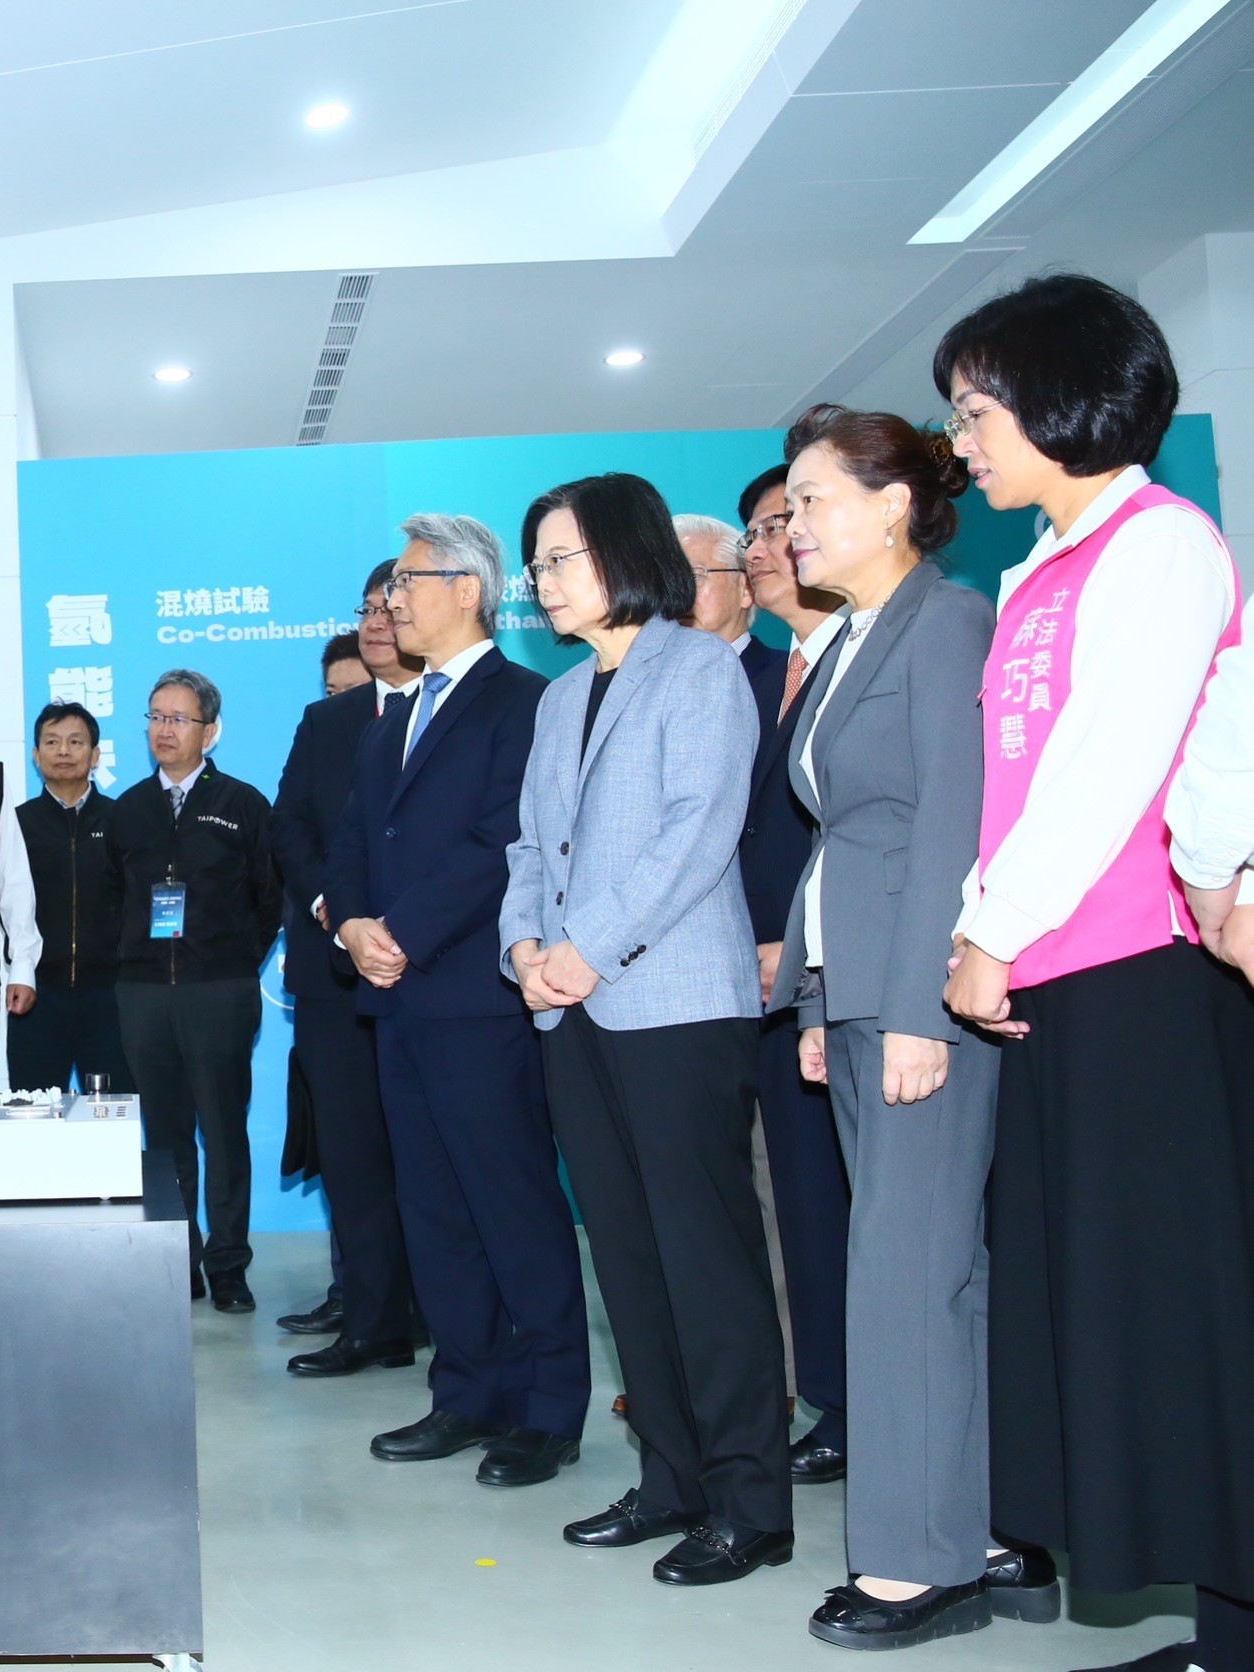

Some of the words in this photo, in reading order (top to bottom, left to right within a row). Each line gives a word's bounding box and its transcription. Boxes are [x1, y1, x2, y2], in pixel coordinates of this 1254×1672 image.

[155, 585, 270, 618] 混燒試驗
[1027, 587, 1070, 713] 立法委員
